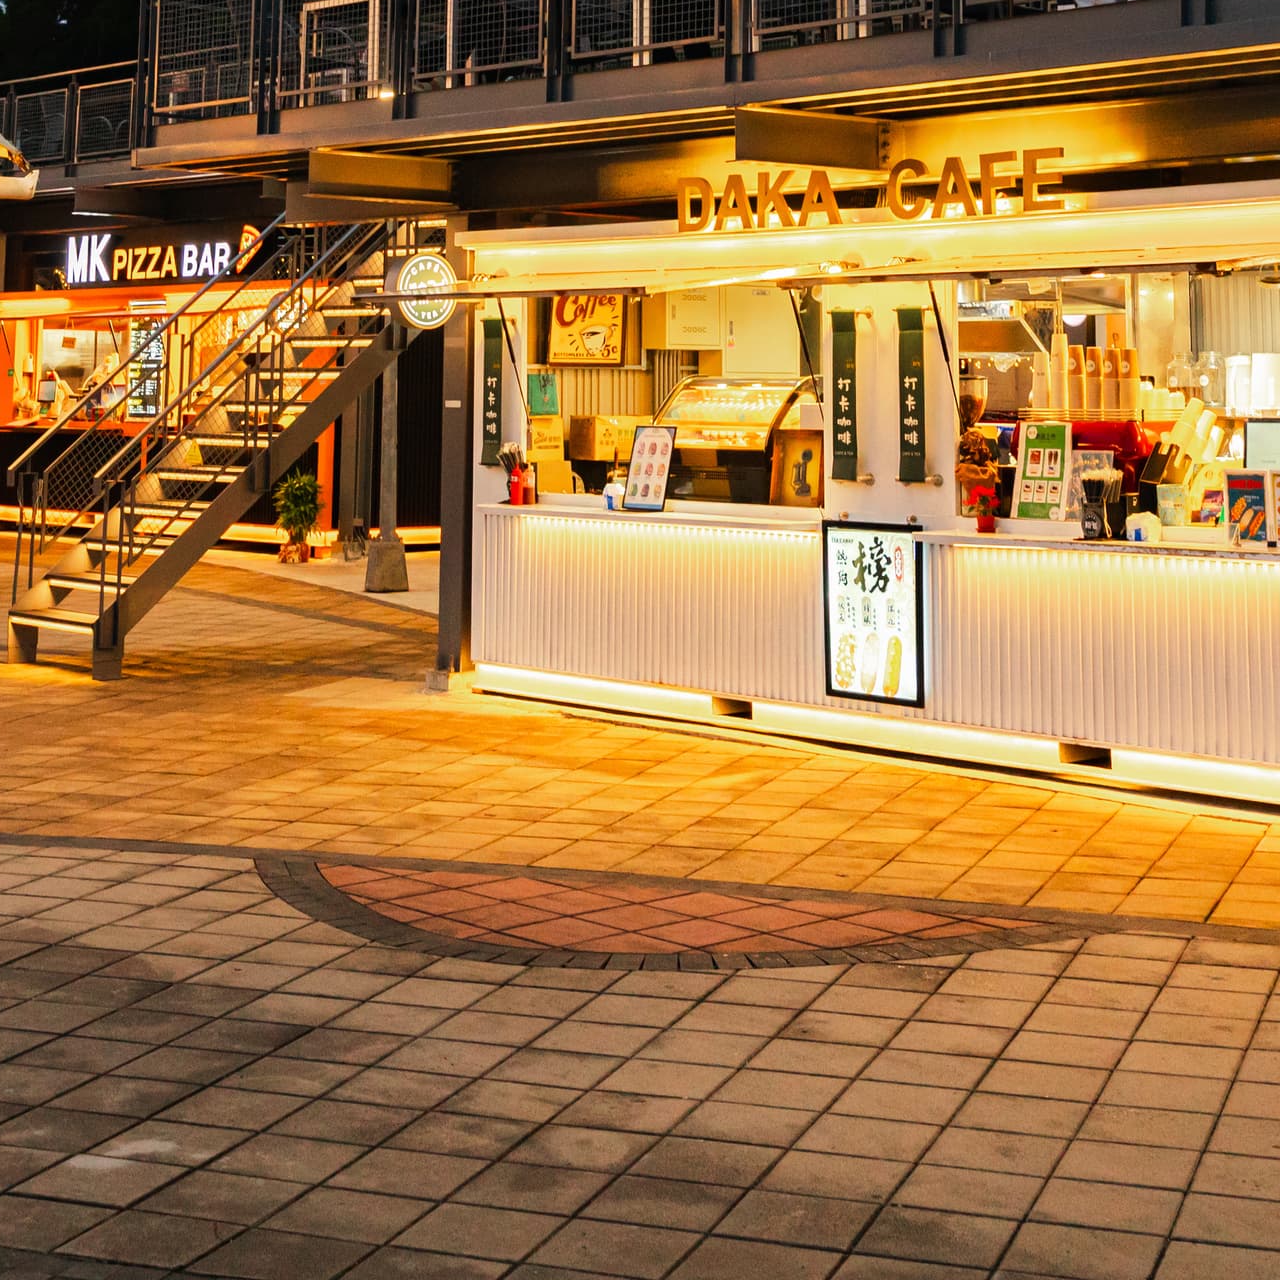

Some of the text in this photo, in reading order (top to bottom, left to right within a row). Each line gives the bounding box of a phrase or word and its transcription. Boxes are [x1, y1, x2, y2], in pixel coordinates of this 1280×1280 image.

[677, 147, 1065, 233] DAKA CAFE
[67, 233, 111, 283] MK
[112, 245, 178, 281] PIZZA
[485, 376, 498, 435] 打卡咖啡
[837, 377, 852, 445] 打卡咖啡
[903, 375, 919, 446] 打卡咖啡
